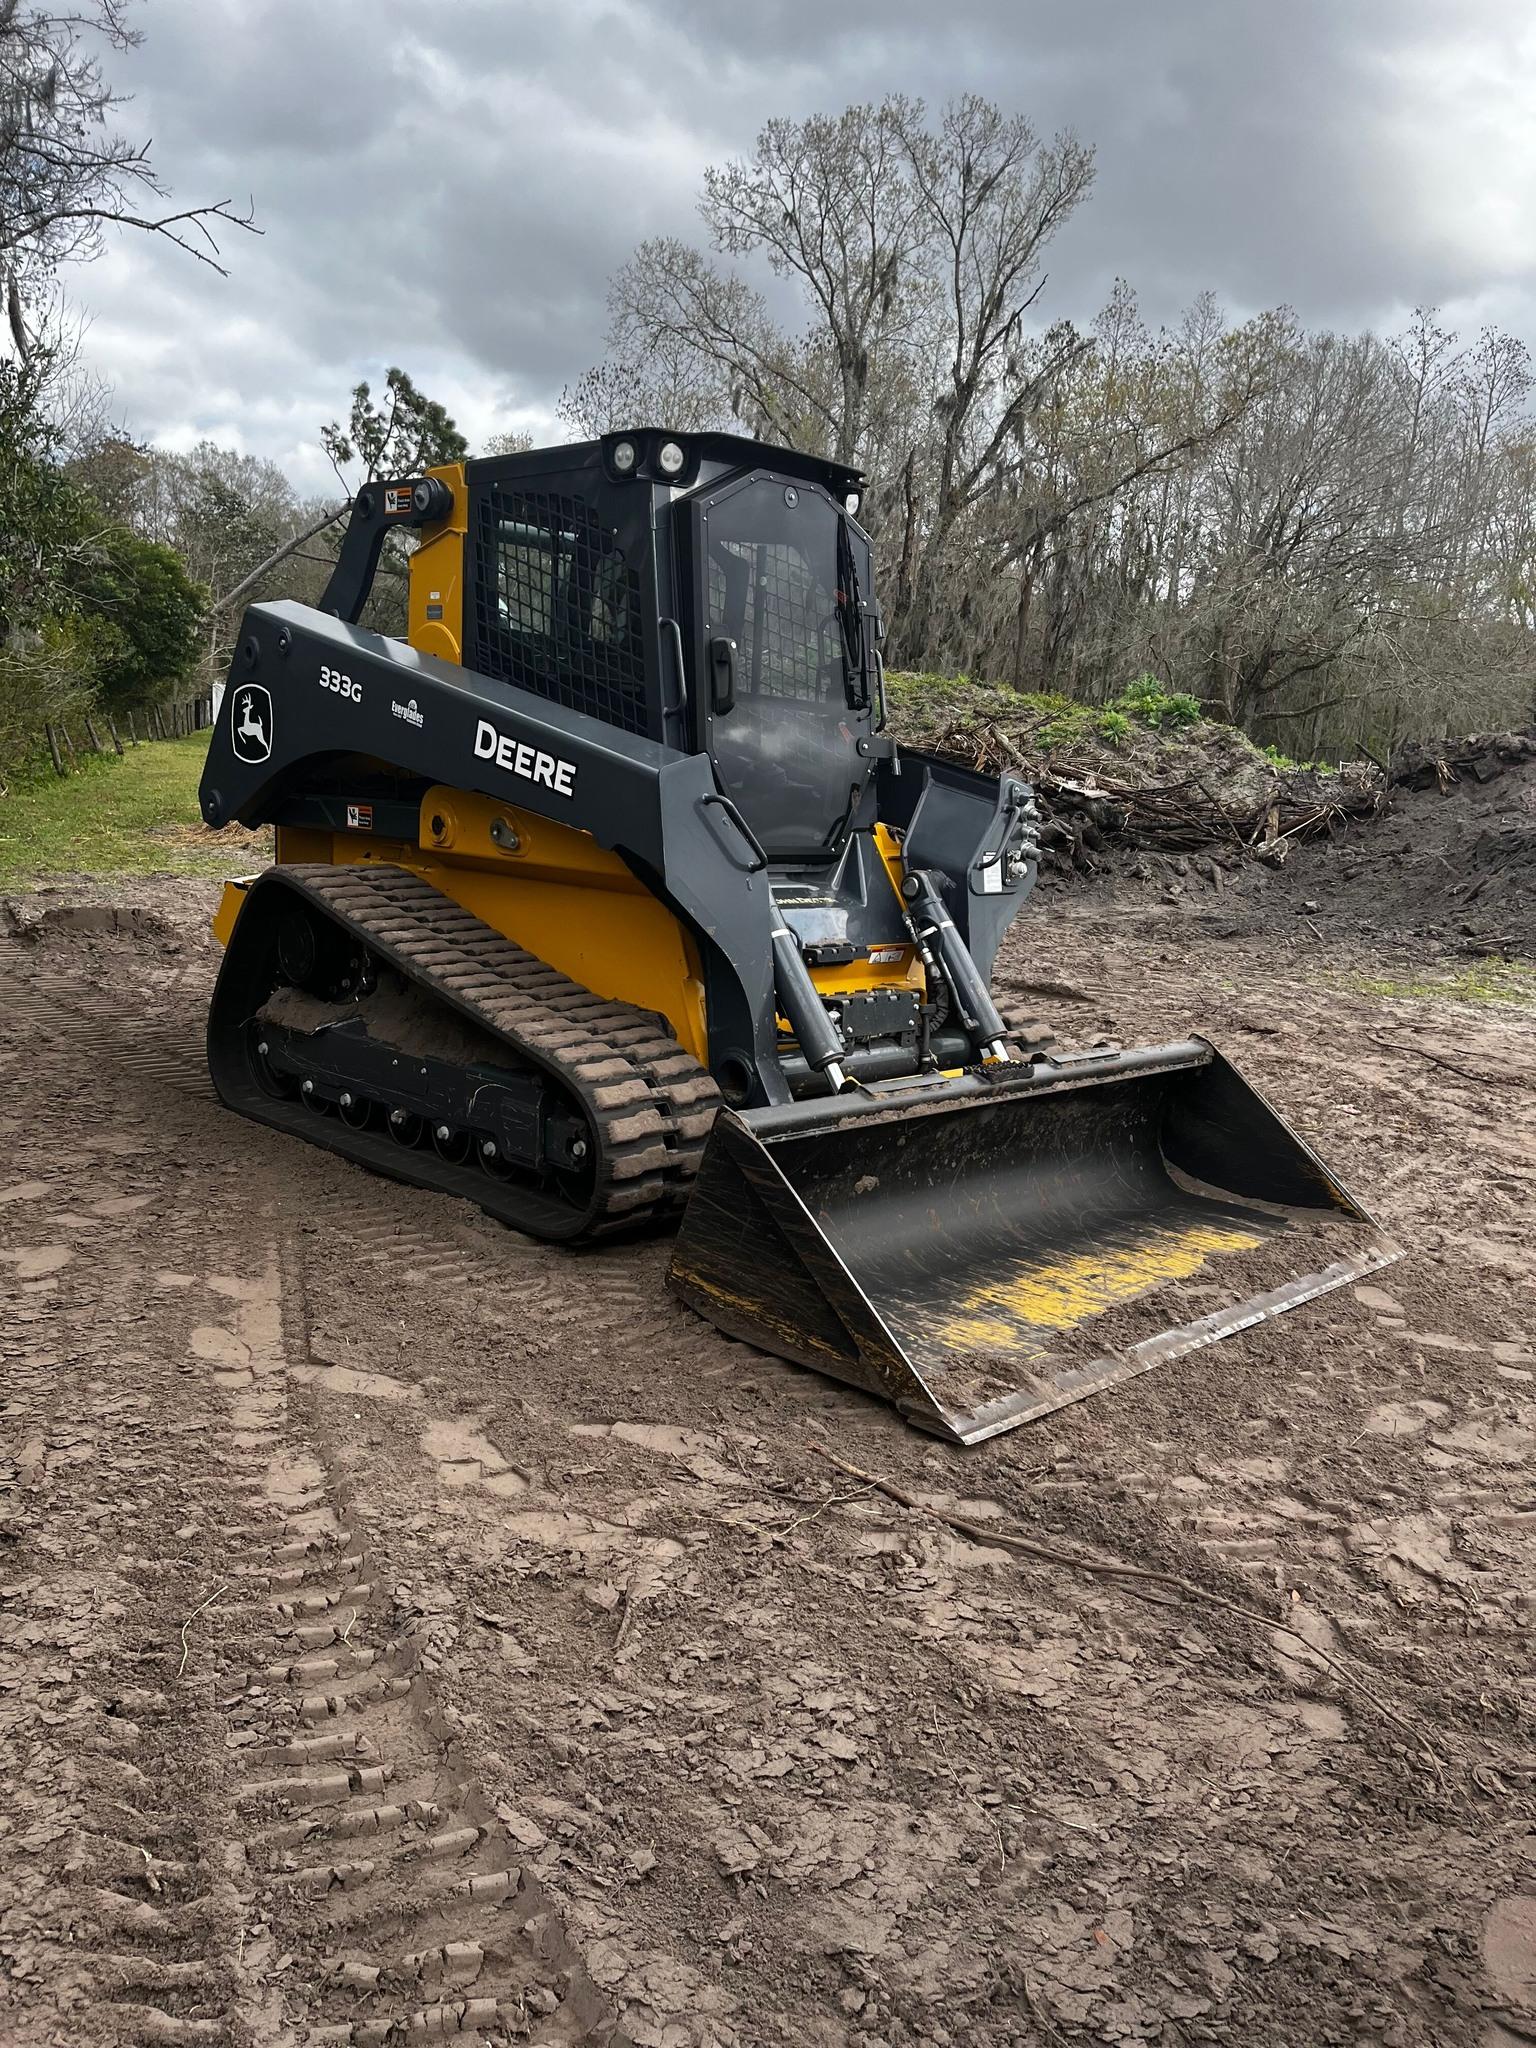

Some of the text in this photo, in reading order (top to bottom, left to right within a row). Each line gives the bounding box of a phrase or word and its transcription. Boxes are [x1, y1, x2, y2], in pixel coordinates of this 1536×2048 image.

[319, 665, 362, 703] 333G
[391, 700, 424, 724] Everglades
[474, 719, 577, 796] DEERE
